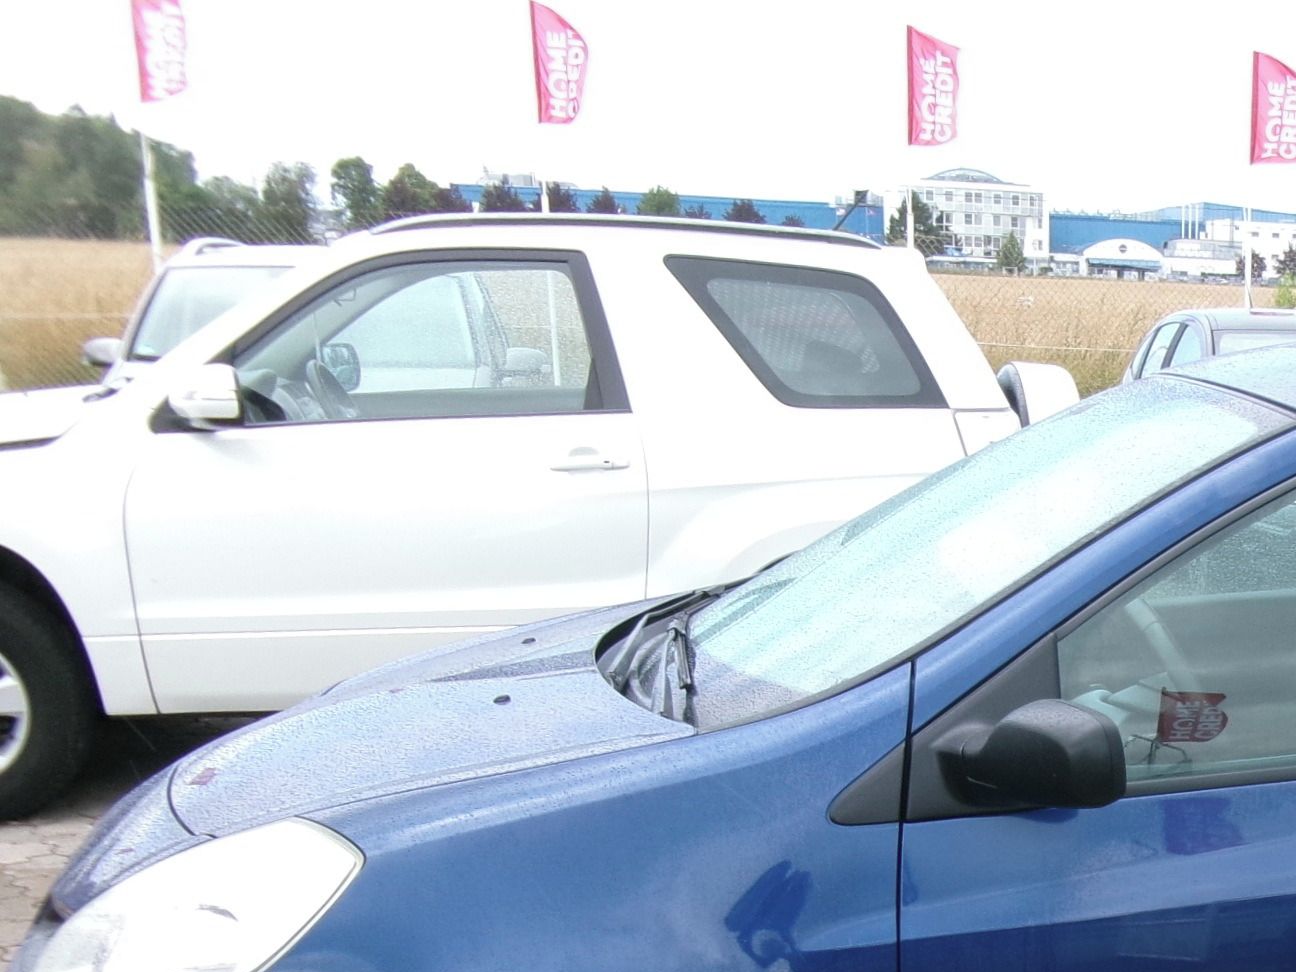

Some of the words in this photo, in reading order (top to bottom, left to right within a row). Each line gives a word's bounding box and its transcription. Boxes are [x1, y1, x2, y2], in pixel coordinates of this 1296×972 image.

[544, 30, 567, 118] HOME
[918, 57, 936, 140] HOME
[934, 49, 954, 143] CREDIT
[1261, 80, 1285, 158] HOME
